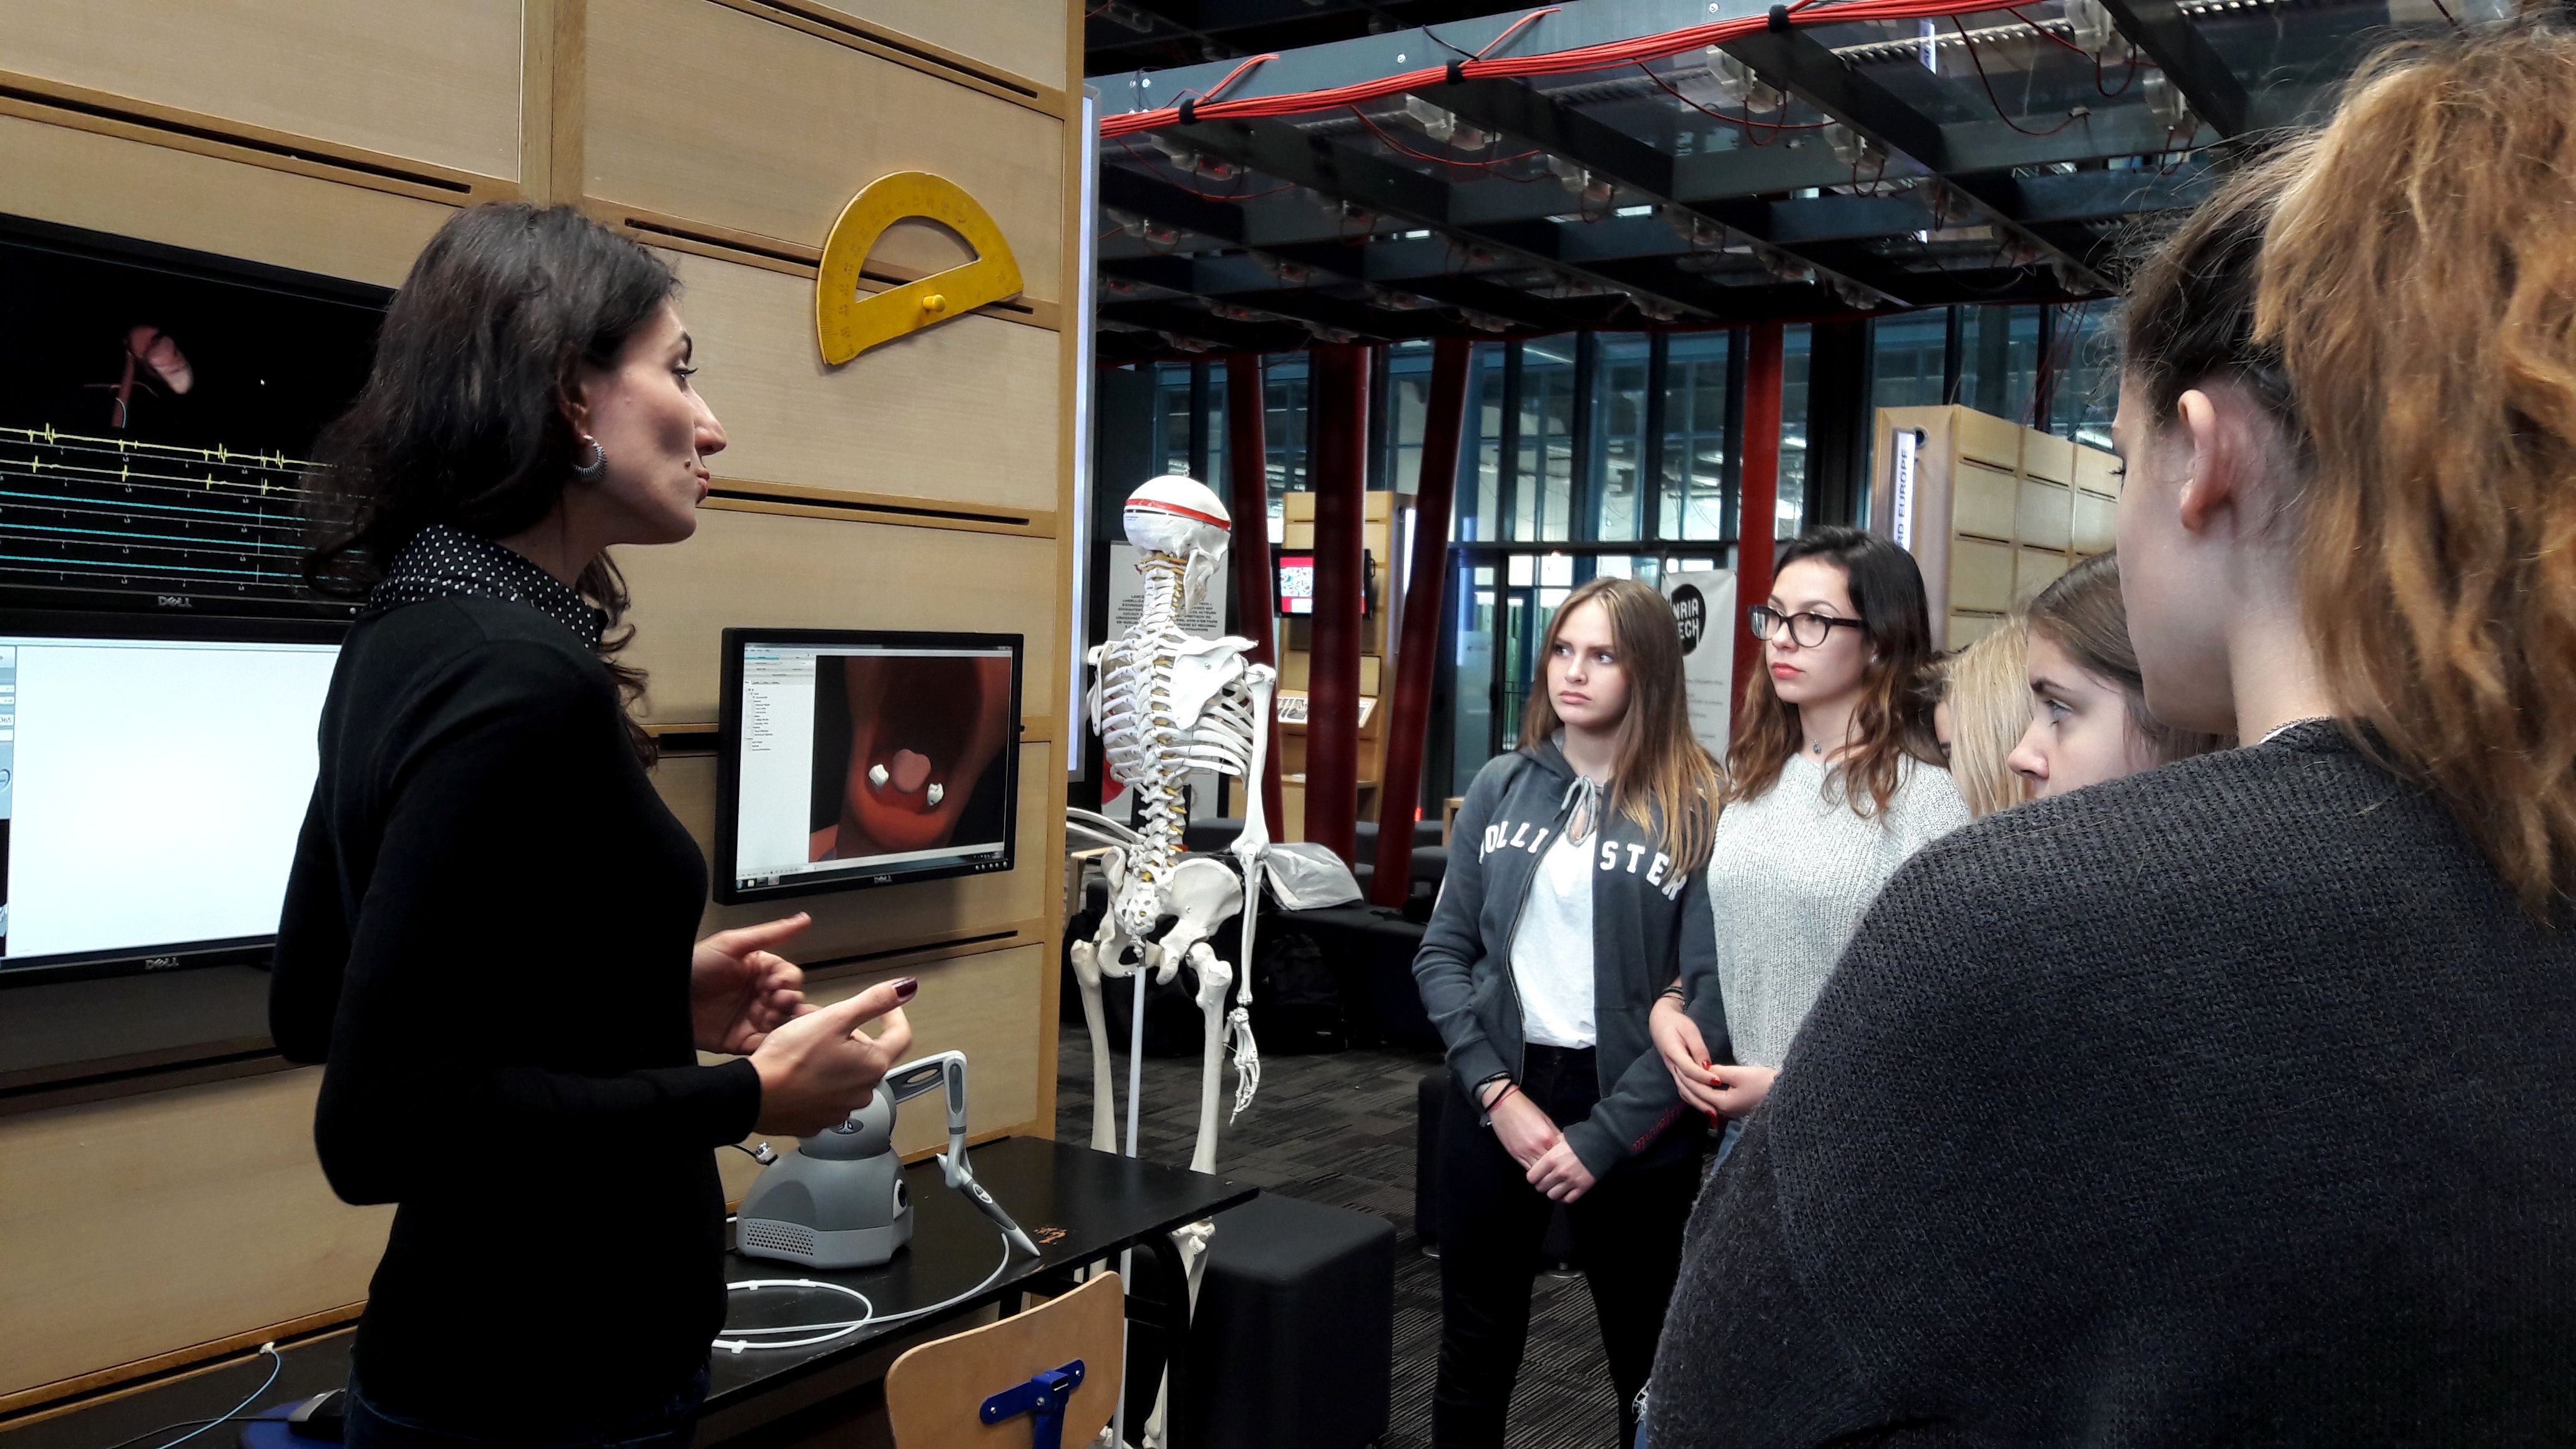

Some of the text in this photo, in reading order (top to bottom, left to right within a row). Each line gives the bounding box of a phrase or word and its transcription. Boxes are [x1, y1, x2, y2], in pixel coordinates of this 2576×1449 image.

[1899, 449, 1908, 517] EUROPE
[157, 595, 193, 608] DELL
[1671, 598, 1699, 621] NRIA
[1676, 618, 1700, 640] ECH
[1479, 821, 1549, 865] OLLI
[145, 957, 180, 970] DELL
